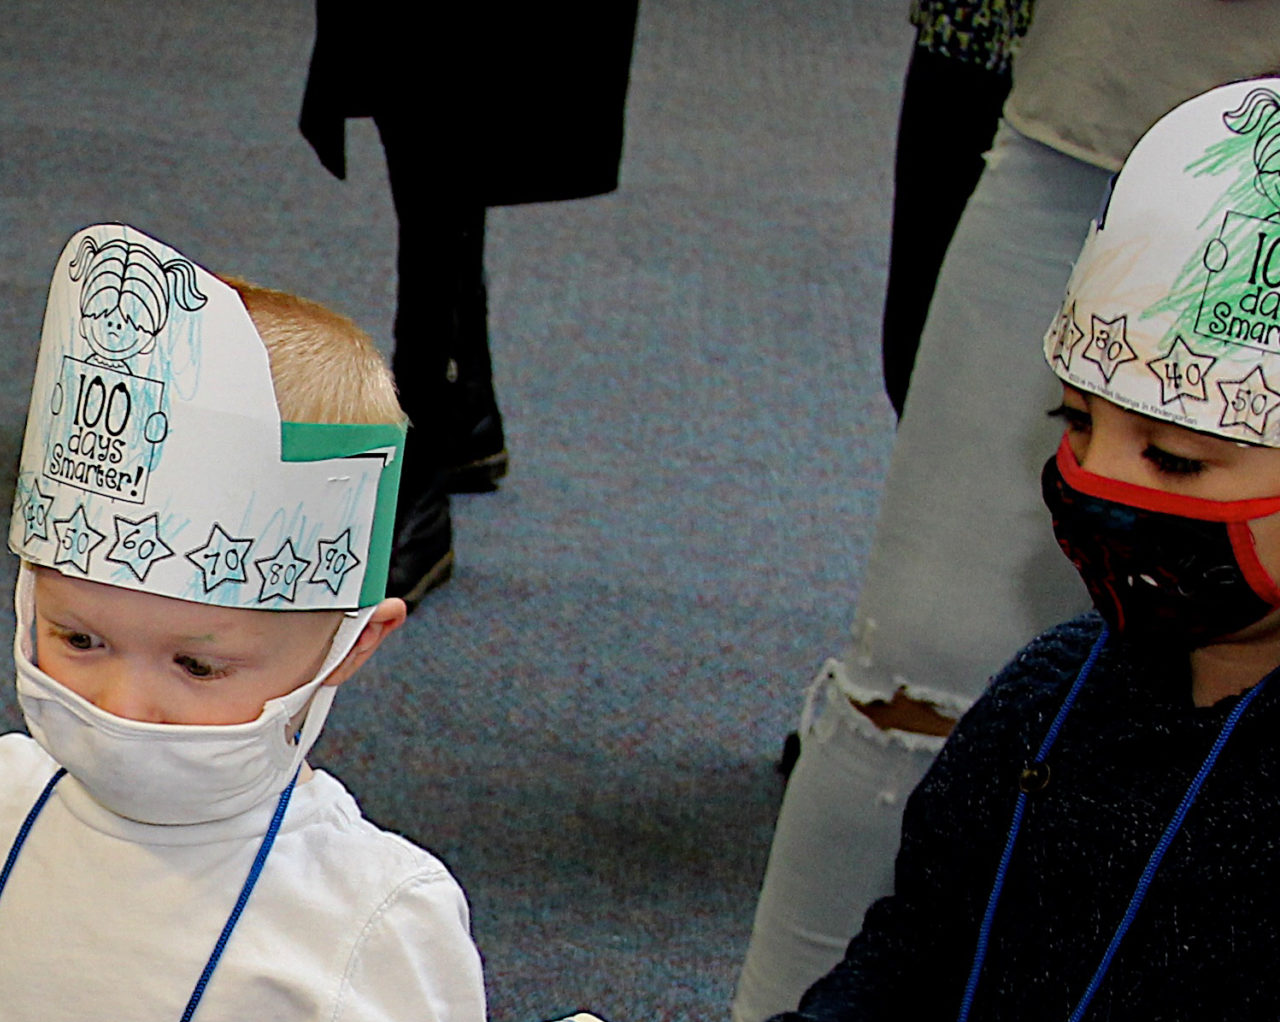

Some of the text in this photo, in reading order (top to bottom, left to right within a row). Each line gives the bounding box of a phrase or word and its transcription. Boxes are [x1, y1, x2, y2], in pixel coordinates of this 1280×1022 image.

[1096, 330, 1122, 361] 30
[1166, 363, 1201, 389] 40
[73, 374, 131, 436] 100
[1231, 389, 1267, 416] 50
[68, 427, 126, 464] days
[50, 445, 145, 497] Smarter!
[61, 527, 89, 555] 50
[122, 527, 155, 559] 60
[203, 549, 240, 577] 70
[271, 562, 296, 587] 80
[325, 546, 348, 575] 90
